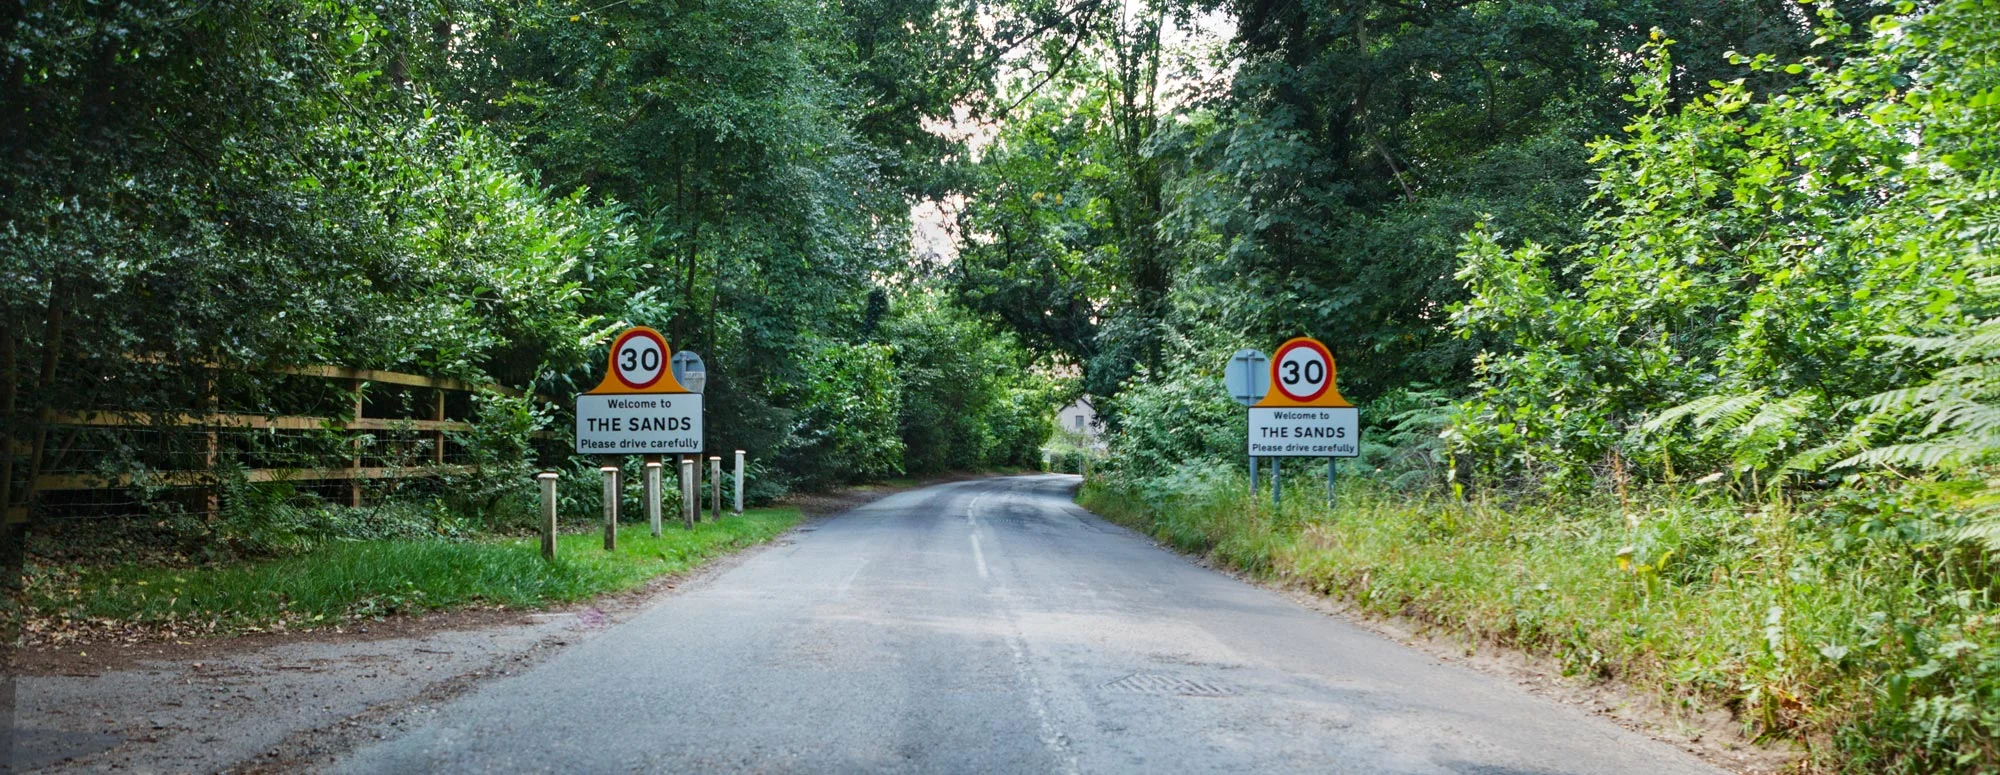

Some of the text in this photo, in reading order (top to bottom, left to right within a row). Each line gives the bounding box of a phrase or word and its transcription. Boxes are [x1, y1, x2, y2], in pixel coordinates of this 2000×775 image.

[620, 348, 660, 372] 30
[1282, 360, 1324, 384] 30
[608, 399, 671, 408] Welcome to
[1274, 412, 1330, 420] Welcome to
[587, 417, 691, 432] THE SANDS
[1260, 427, 1345, 438] THE SANDS
[581, 438, 698, 449] Please drive carefully
[1252, 443, 1354, 453] Please drive carefully
